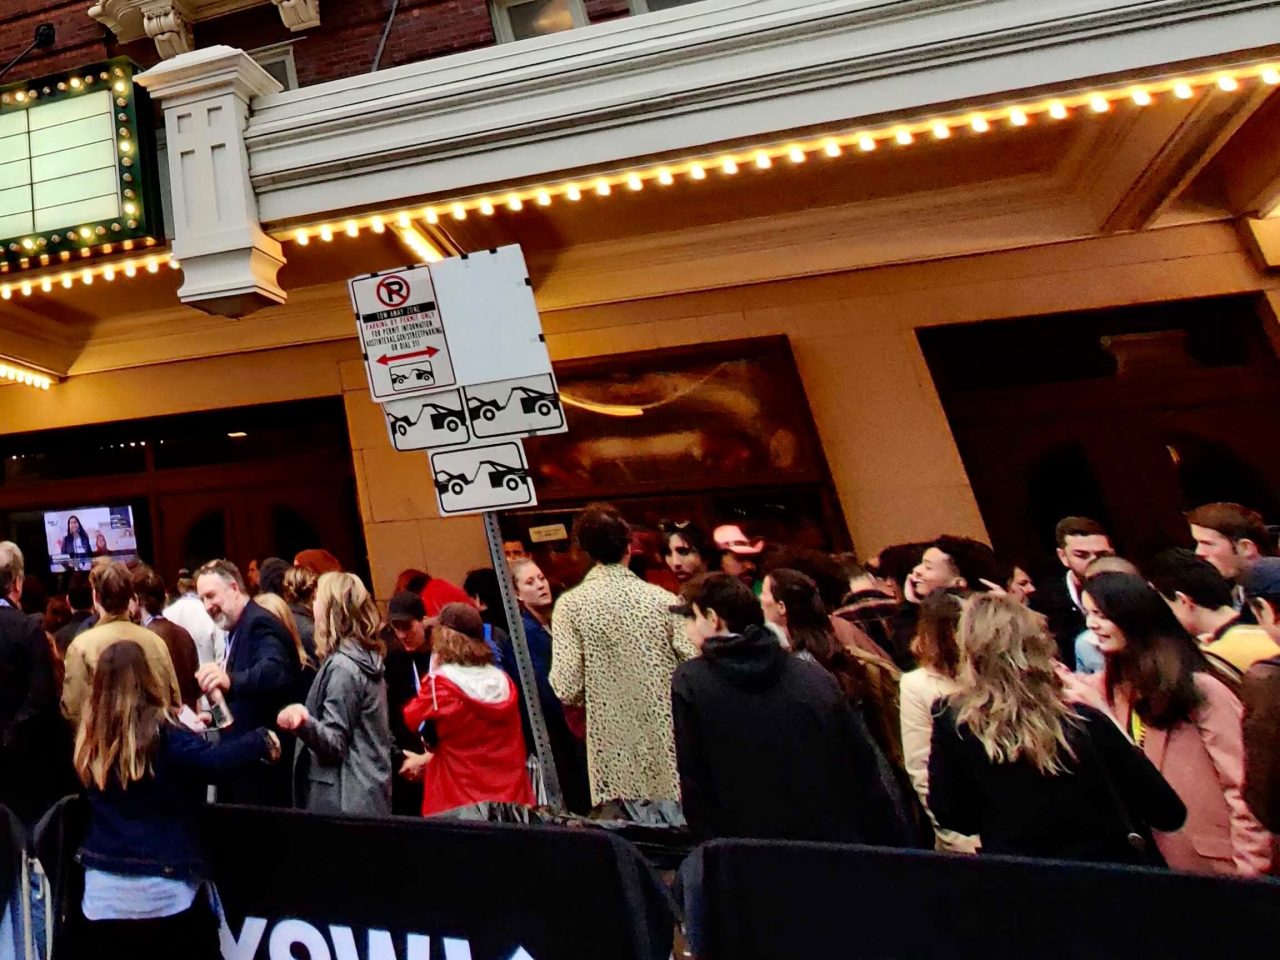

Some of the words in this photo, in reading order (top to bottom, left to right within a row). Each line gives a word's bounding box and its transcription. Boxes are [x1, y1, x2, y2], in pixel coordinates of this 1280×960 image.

[366, 322, 387, 330] PARKING
[400, 315, 418, 324] PERMIT
[421, 311, 435, 320] ONLY
[377, 311, 388, 320] TOW
[390, 308, 404, 317] AWAY
[371, 329, 381, 338] FOR
[383, 325, 400, 334] PERMIT
[402, 320, 433, 331] INFORMATION
